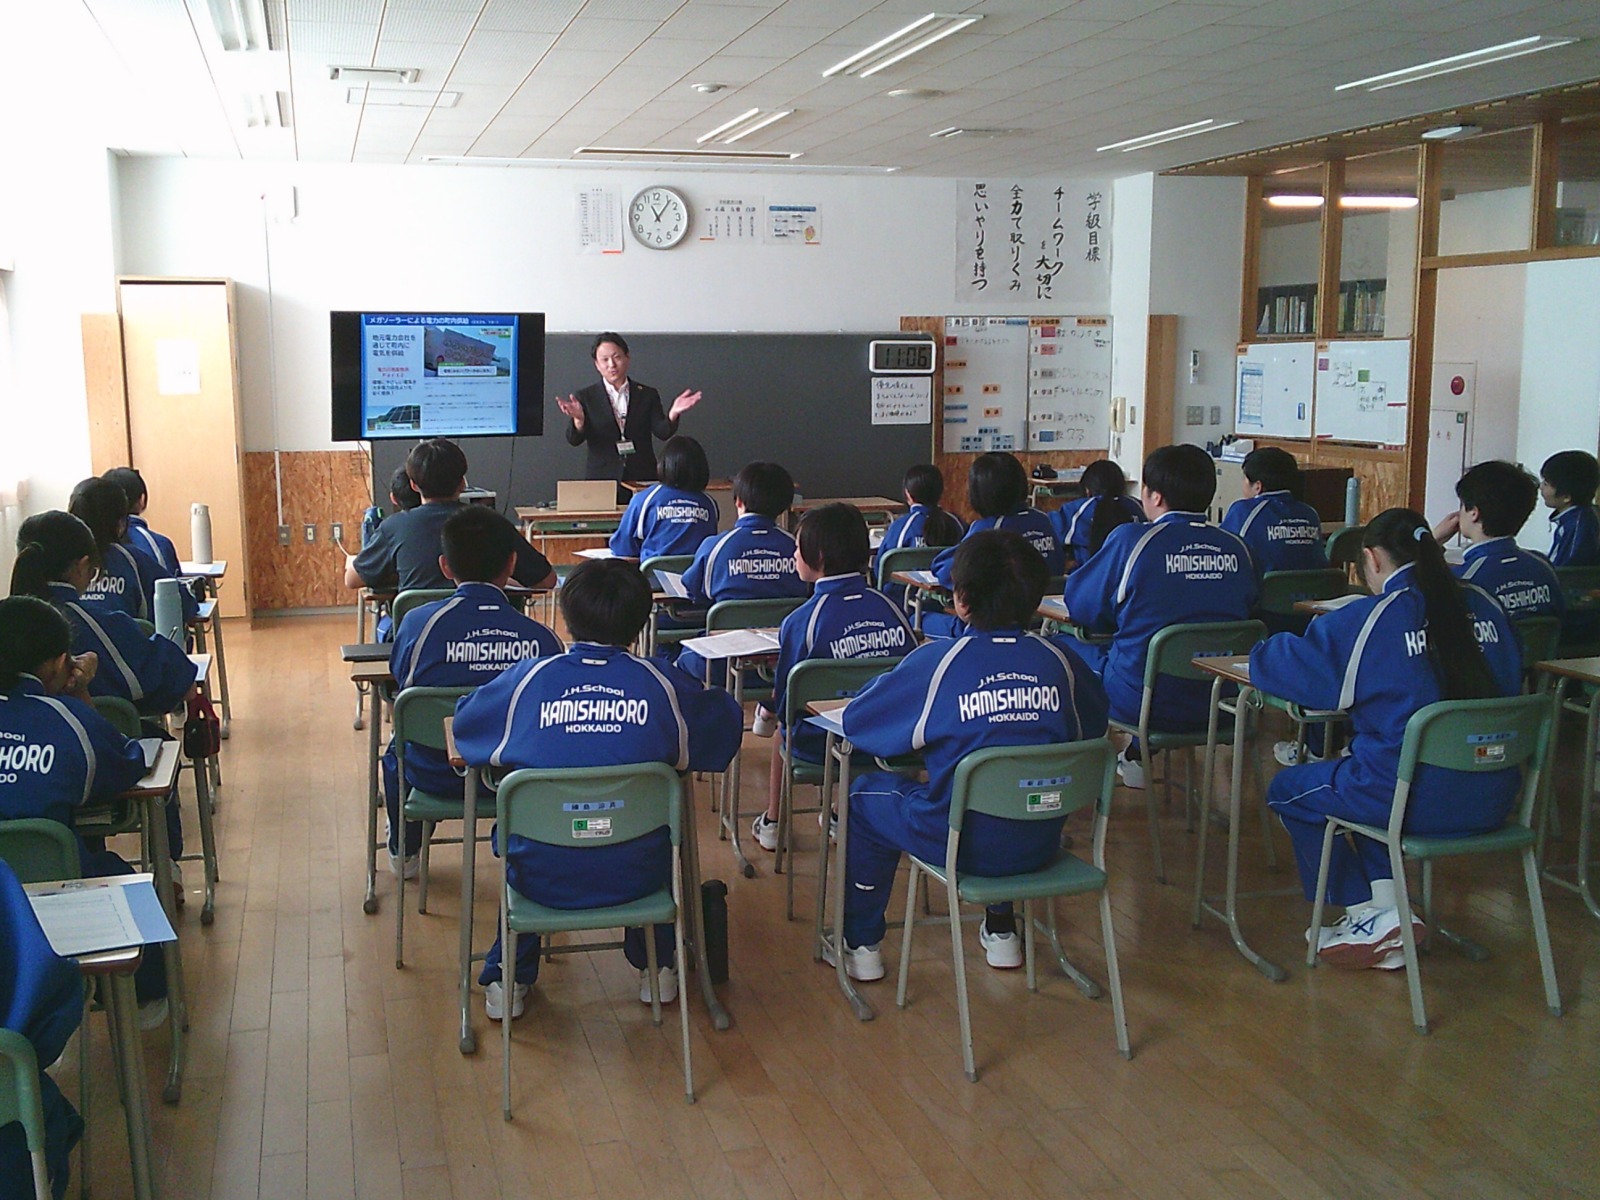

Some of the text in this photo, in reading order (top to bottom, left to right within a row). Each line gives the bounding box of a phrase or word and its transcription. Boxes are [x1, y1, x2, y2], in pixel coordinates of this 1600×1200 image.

[643, 195, 650, 204] 11
[652, 192, 661, 201] 12
[635, 202, 645, 212] 10
[672, 202, 678, 211] 2
[633, 213, 641, 223] 9
[675, 212, 681, 222] 3
[637, 224, 644, 234] 8
[673, 224, 679, 232] 4
[1052, 186, 1066, 277] チームワーク
[646, 231, 652, 240] 7
[655, 235, 663, 244] 6
[666, 230, 672, 240] 5
[971, 183, 989, 291] 思いやりを持つ
[885, 346, 928, 367] 11:06
[656, 505, 710, 522] KAMISHIHORO
[728, 557, 796, 577] KAMISHIHORO
[1165, 553, 1238, 574] KAMISHIHORO
[1185, 572, 1223, 580] HOKKAIDO
[843, 620, 886, 636] J.H.School
[464, 628, 519, 641] J.H.School
[829, 625, 906, 660] KAMISHIHORO
[446, 639, 540, 663] KAMISHIHORO
[977, 672, 1039, 689] J.H.School
[560, 684, 625, 698] J.H.School
[958, 685, 1061, 723] KAMISHIHORO
[539, 699, 649, 730] KAMISHIHORO
[988, 711, 1040, 723] HOKKAIDO
[565, 723, 622, 734] HOKKAIDO
